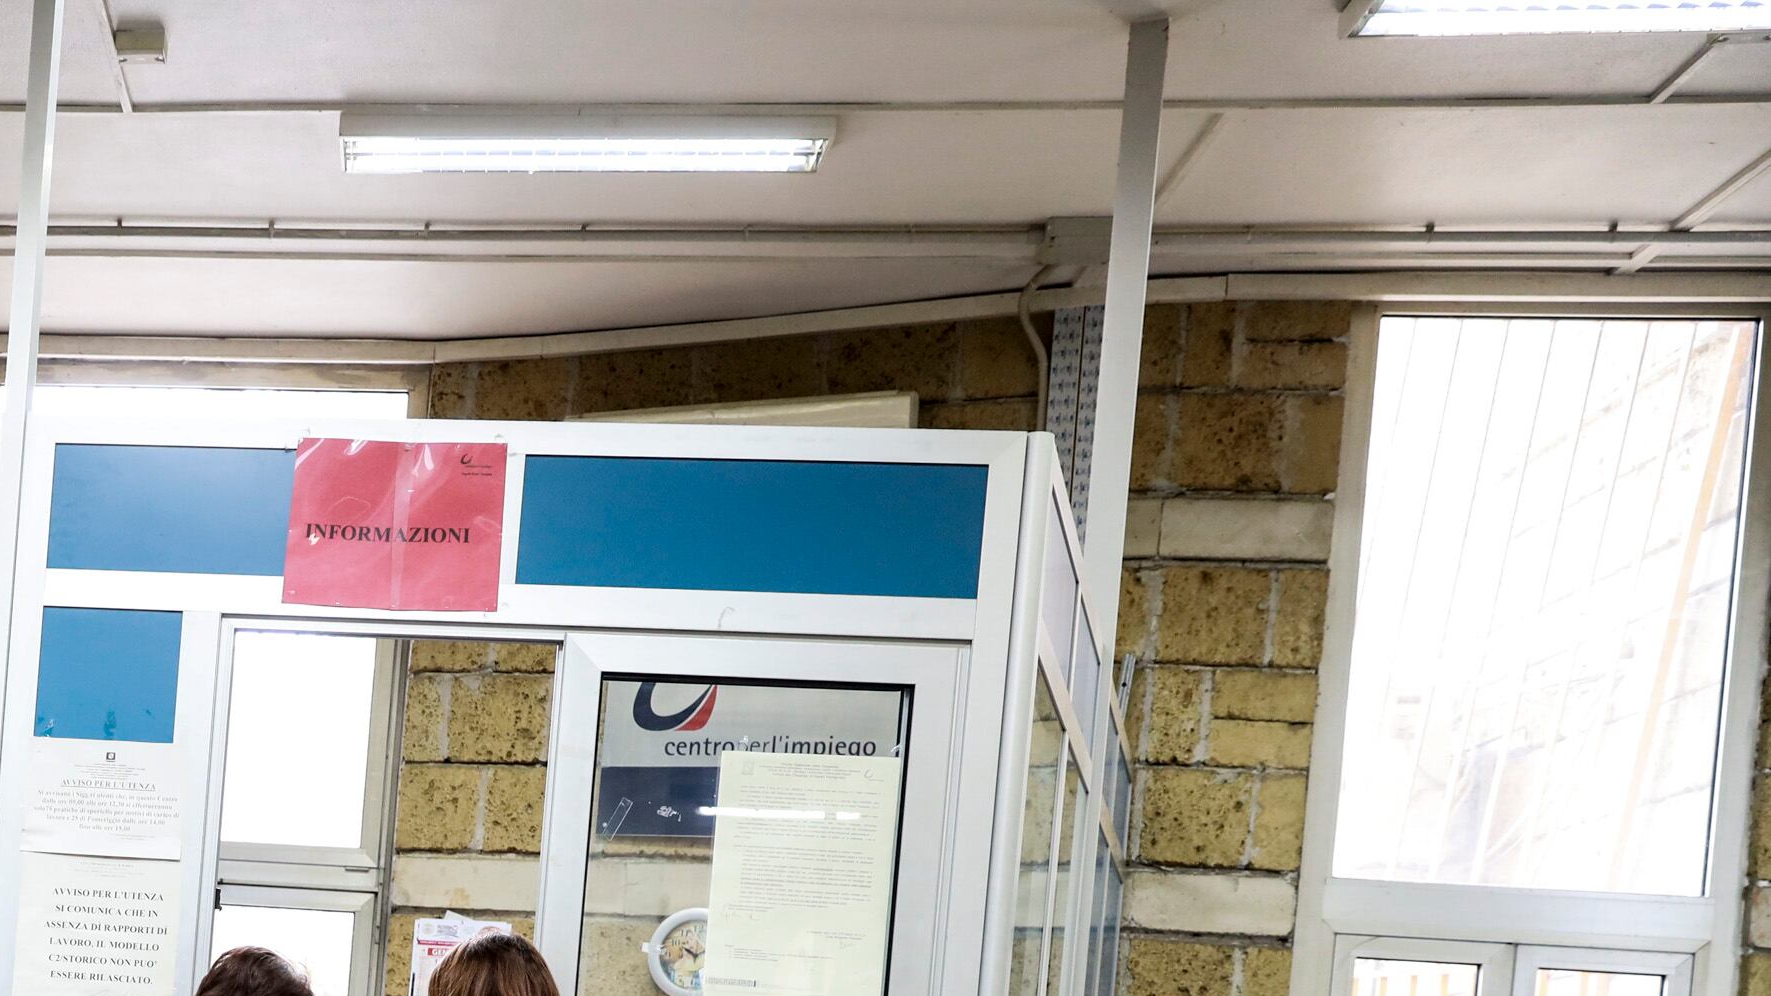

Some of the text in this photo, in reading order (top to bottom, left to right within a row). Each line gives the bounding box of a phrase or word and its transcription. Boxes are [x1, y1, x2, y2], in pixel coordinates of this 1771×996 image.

[305, 522, 470, 544] INFORMAZIONI
[52, 887, 164, 902] AVVISO PER L'UTENZA
[54, 904, 159, 918] SI COMUNICA CHE IN
[44, 920, 168, 935] ASSENZA DI RAPPORTI DI
[96, 940, 107, 949] IL
[109, 941, 160, 952] MODELLO
[109, 957, 131, 967] NON
[50, 970, 87, 980] ESSERE
